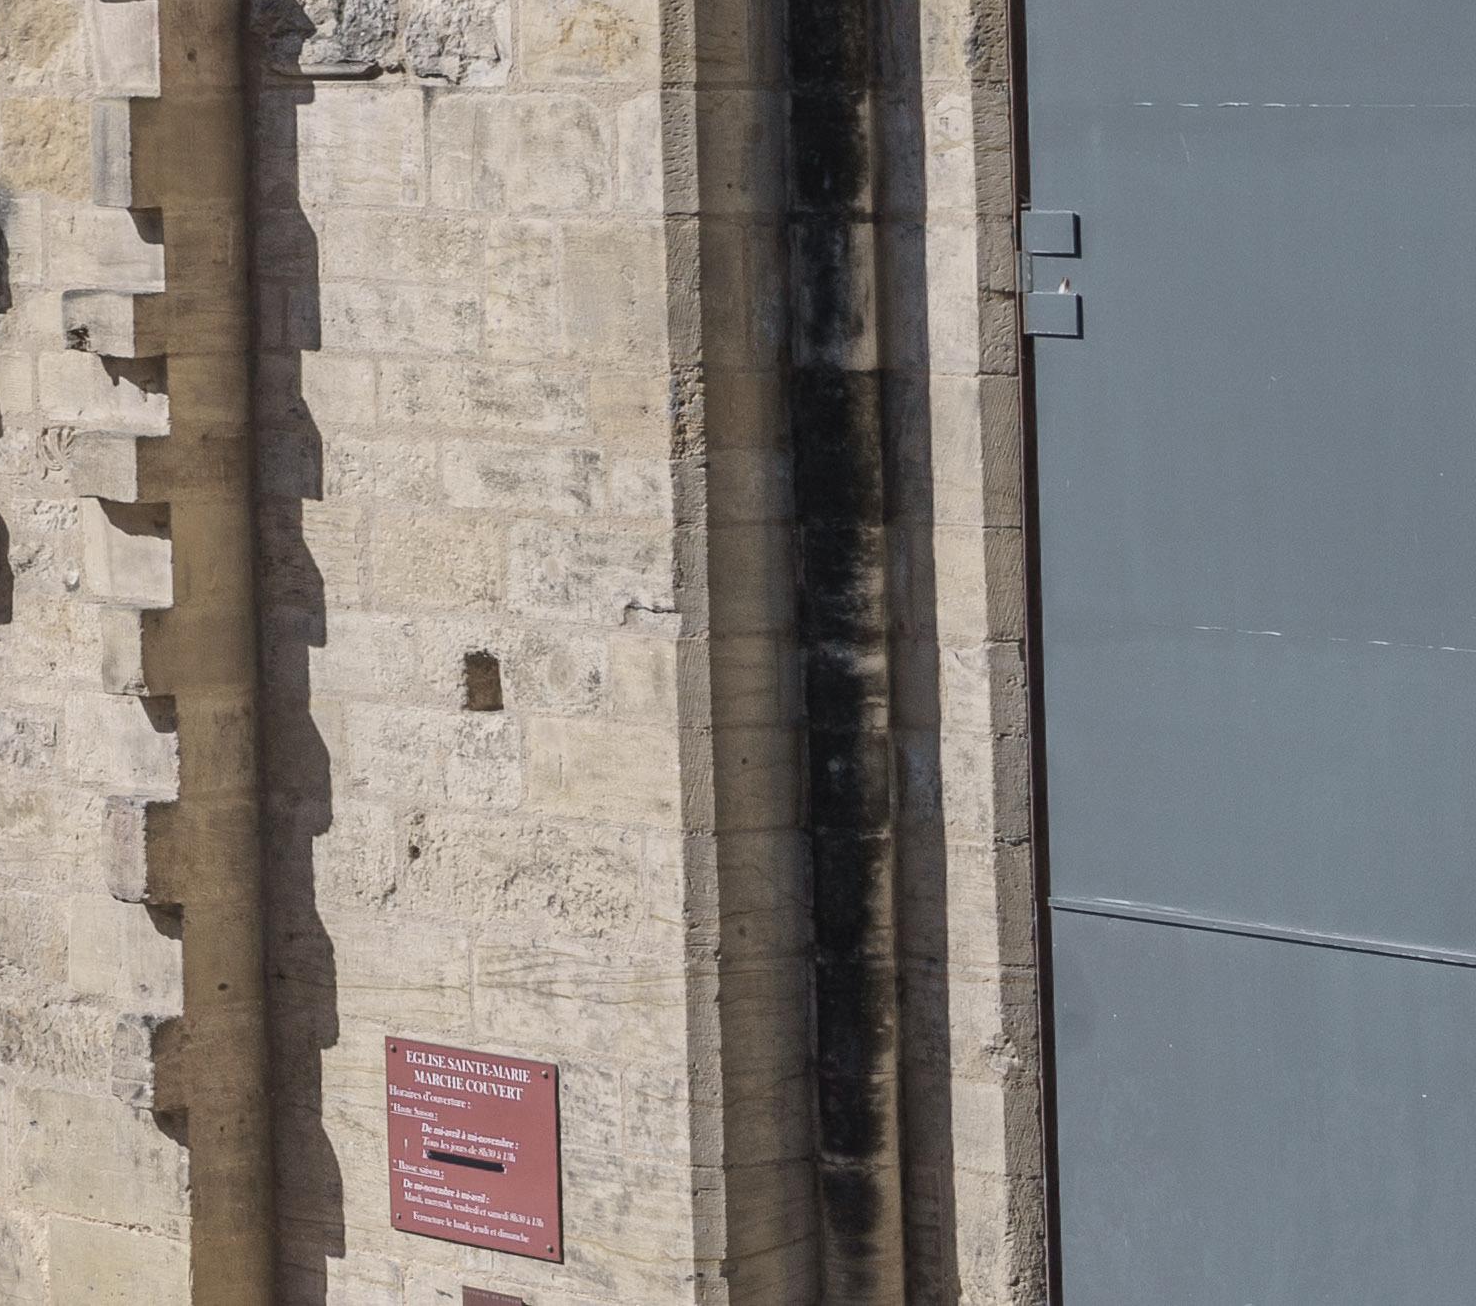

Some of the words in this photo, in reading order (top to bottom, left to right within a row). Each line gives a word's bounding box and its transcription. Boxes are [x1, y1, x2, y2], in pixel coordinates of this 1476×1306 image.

[405, 1050, 446, 1069] EGLISE
[447, 1058, 531, 1083] SAINTE-MARIE
[388, 1084, 422, 1101] Horaires
[423, 1090, 467, 1108] d'ouverture
[414, 1070, 465, 1090] MARCHE
[465, 1080, 524, 1101] COUVERT
[421, 1122, 432, 1133] De
[422, 1136, 439, 1148] Tous
[440, 1141, 449, 1152] les
[449, 1143, 467, 1155] jours
[403, 1179, 413, 1189] De
